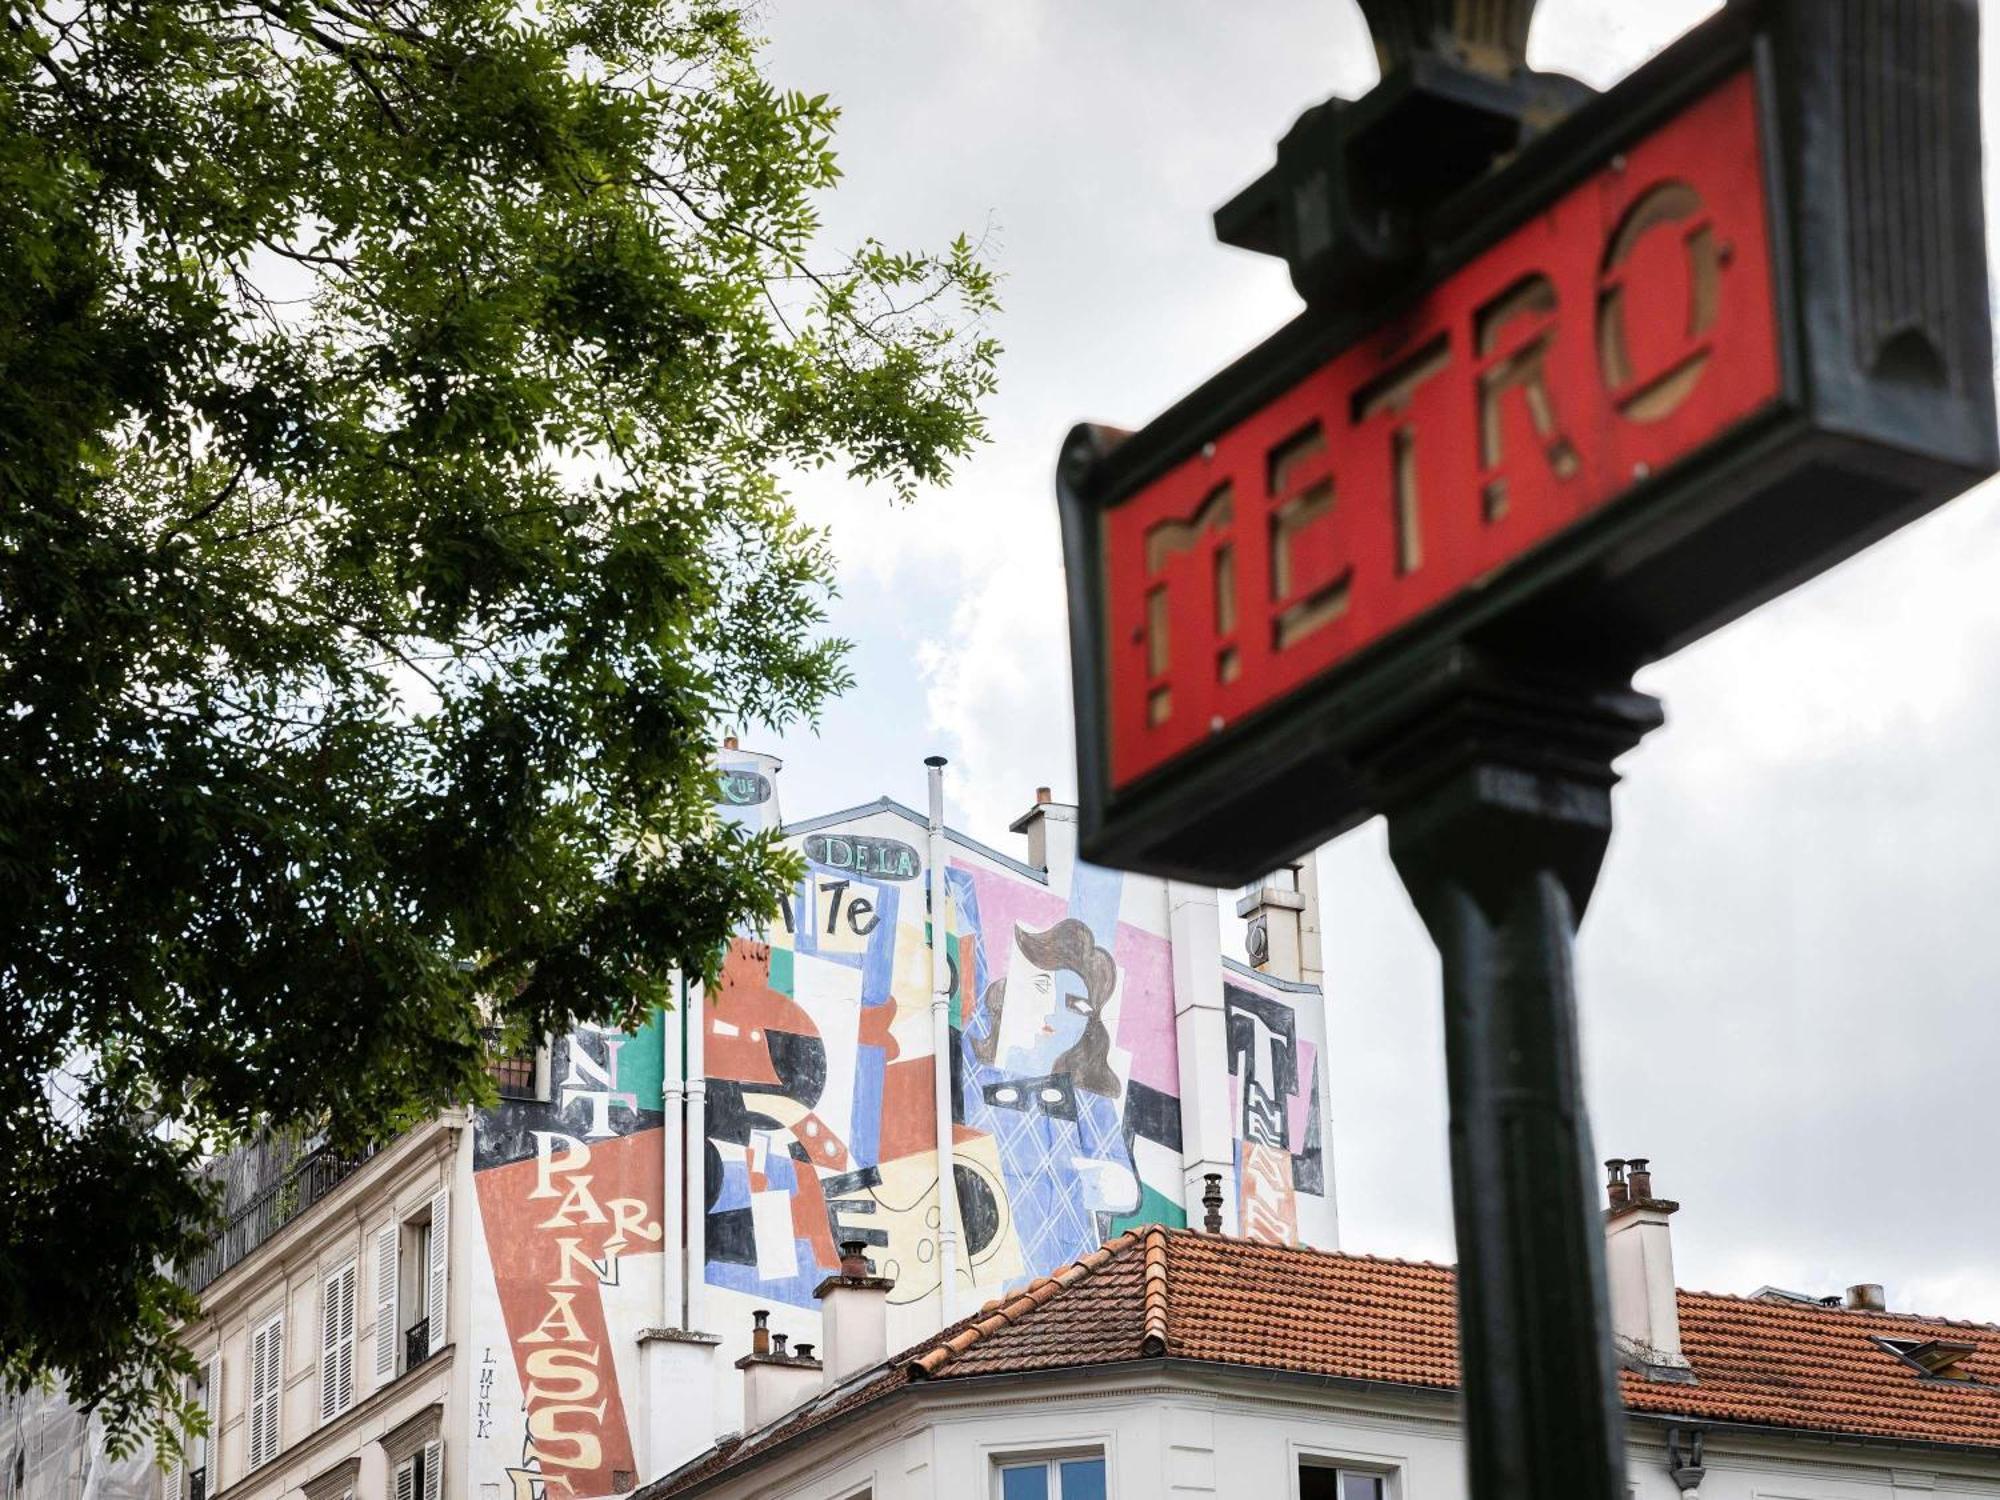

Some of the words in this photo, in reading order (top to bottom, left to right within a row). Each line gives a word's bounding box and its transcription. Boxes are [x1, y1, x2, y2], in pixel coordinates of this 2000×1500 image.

[1143, 177, 1722, 732] METRO
[824, 838, 868, 871] DE
[876, 847, 914, 878] LA
[477, 1368, 494, 1439] MUNK
